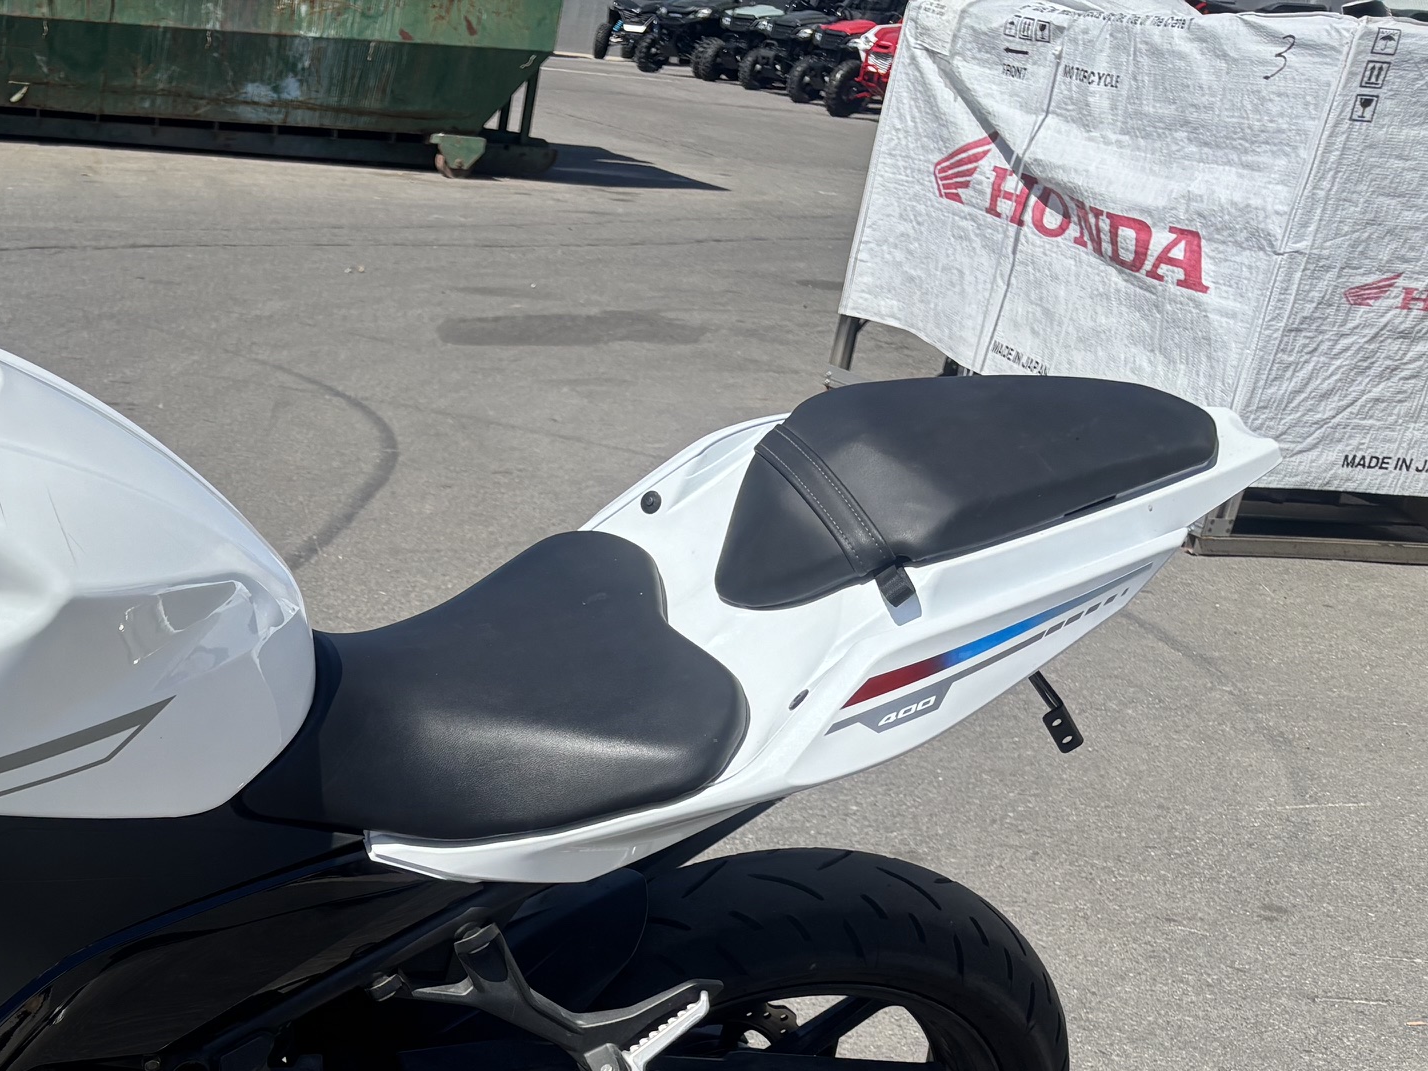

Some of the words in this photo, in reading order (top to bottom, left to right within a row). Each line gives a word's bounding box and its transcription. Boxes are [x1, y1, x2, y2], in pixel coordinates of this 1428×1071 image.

[1262, 34, 1295, 80] 3
[1001, 62, 1028, 79] FRONT
[1063, 64, 1120, 89] MOTORCYCLE
[985, 165, 1210, 294] HONDA
[992, 340, 1014, 361] MADE
[1012, 350, 1023, 366] IN
[1342, 454, 1392, 471] MADE
[1394, 457, 1413, 472] IN
[878, 695, 936, 727] 400
